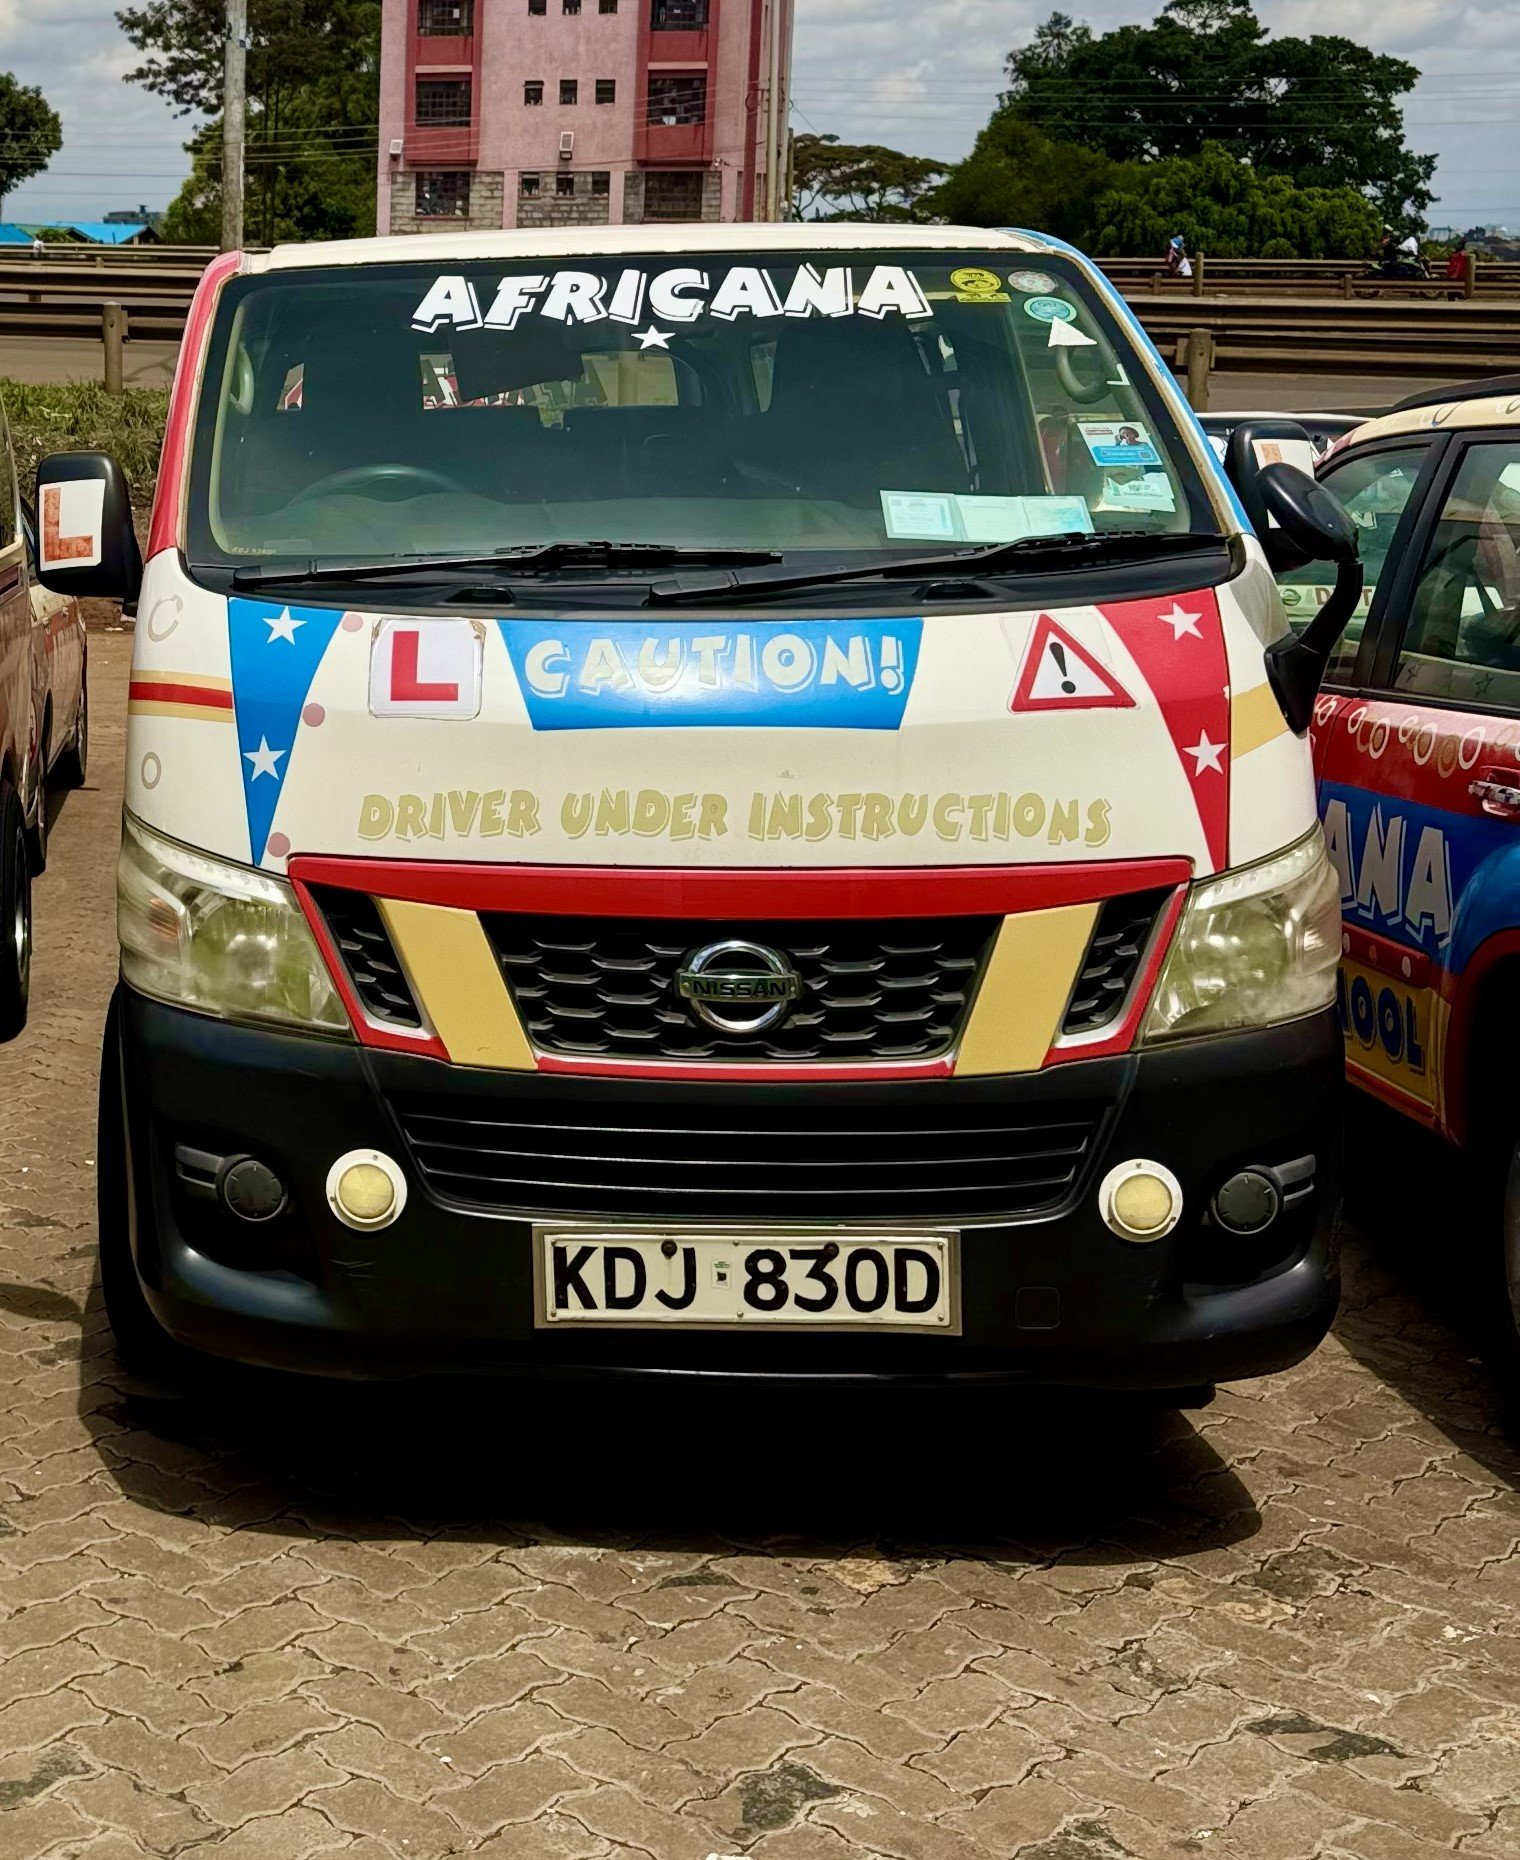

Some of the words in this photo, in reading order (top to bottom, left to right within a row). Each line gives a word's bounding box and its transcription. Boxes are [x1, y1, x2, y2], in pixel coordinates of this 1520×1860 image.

[411, 262, 933, 333] AFRICANA
[44, 487, 94, 562] L
[391, 631, 459, 701] L
[524, 634, 905, 698] CAUTION!
[358, 789, 542, 842] DRIVER
[560, 787, 729, 842] UNDER
[748, 790, 1112, 847] INSTRUCTIONS
[693, 980, 786, 996] NISSAN
[553, 1245, 697, 1310] KDJ
[743, 1248, 940, 1313] 830D
